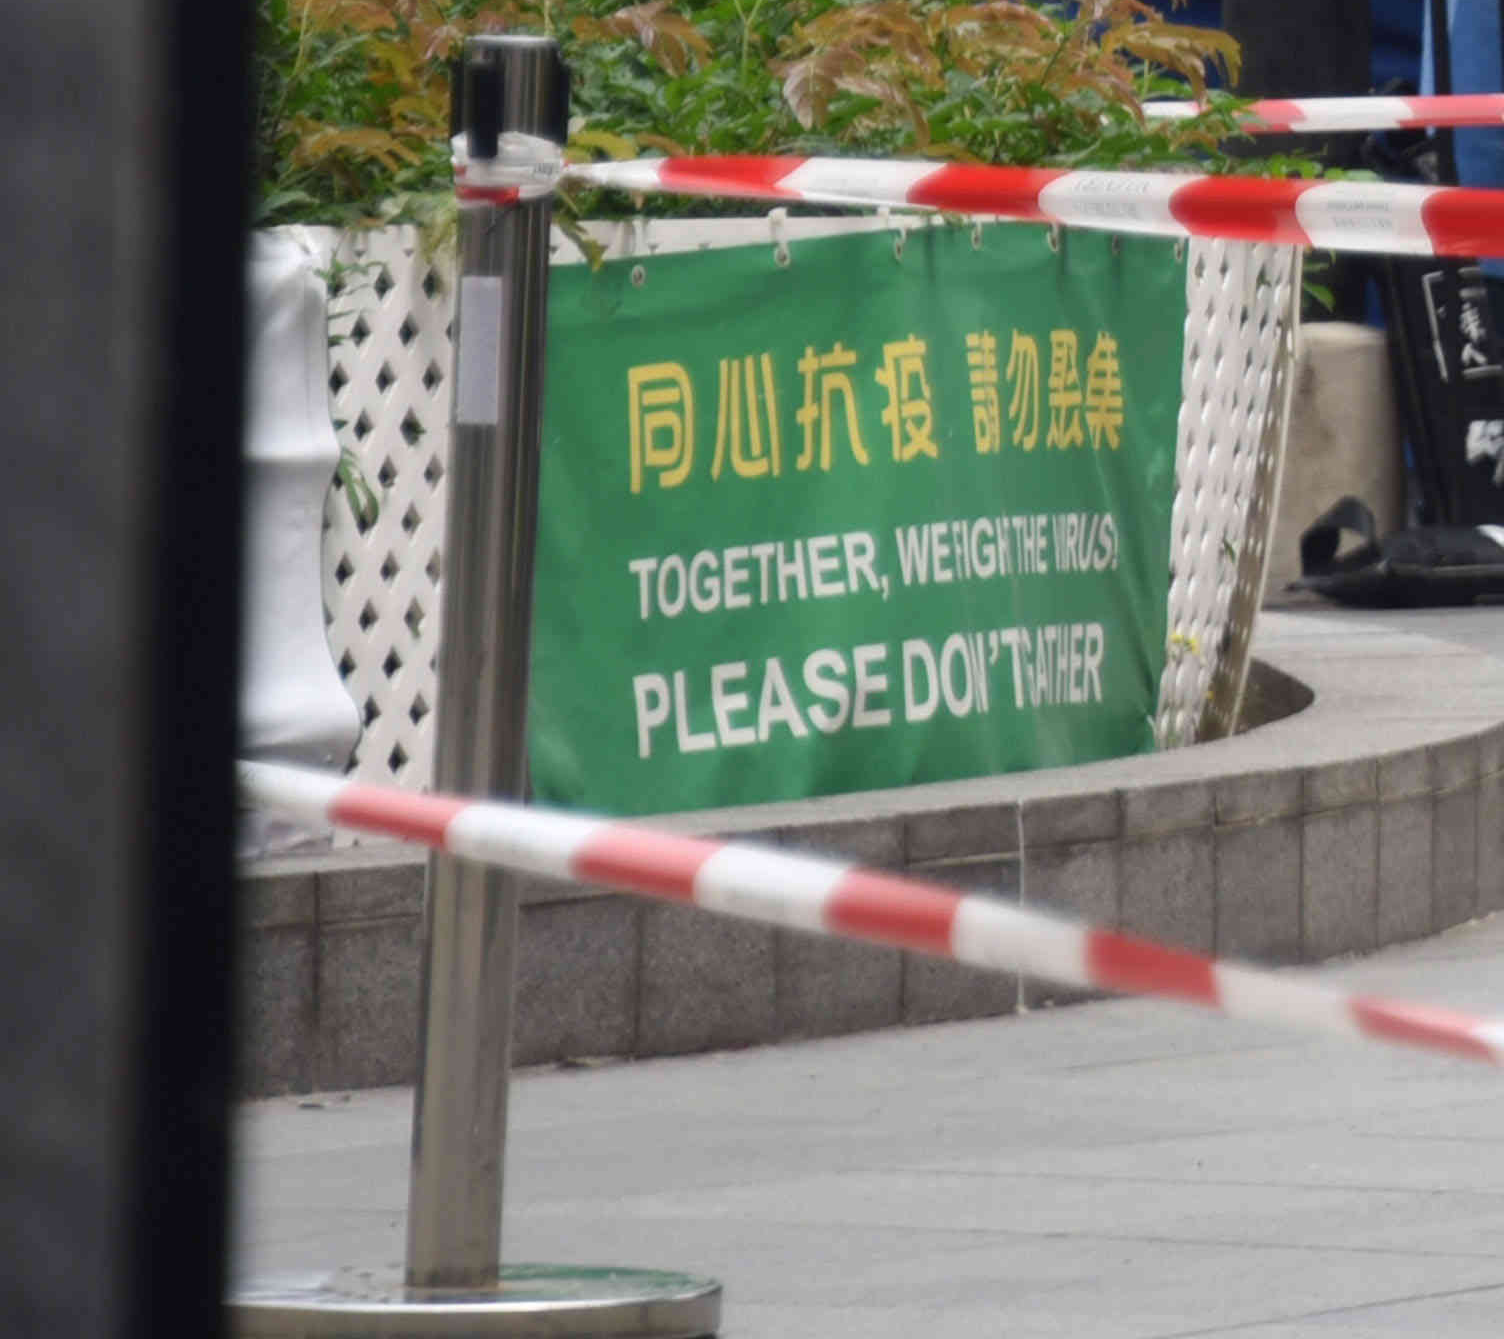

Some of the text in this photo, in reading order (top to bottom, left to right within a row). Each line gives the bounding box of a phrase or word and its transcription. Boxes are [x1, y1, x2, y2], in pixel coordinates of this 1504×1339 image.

[627, 333, 939, 494] 同心抗疫
[628, 531, 890, 620] TOGETHER,
[895, 522, 952, 586] WE
[1012, 513, 1048, 575] THE
[632, 643, 893, 759] PLEASE
